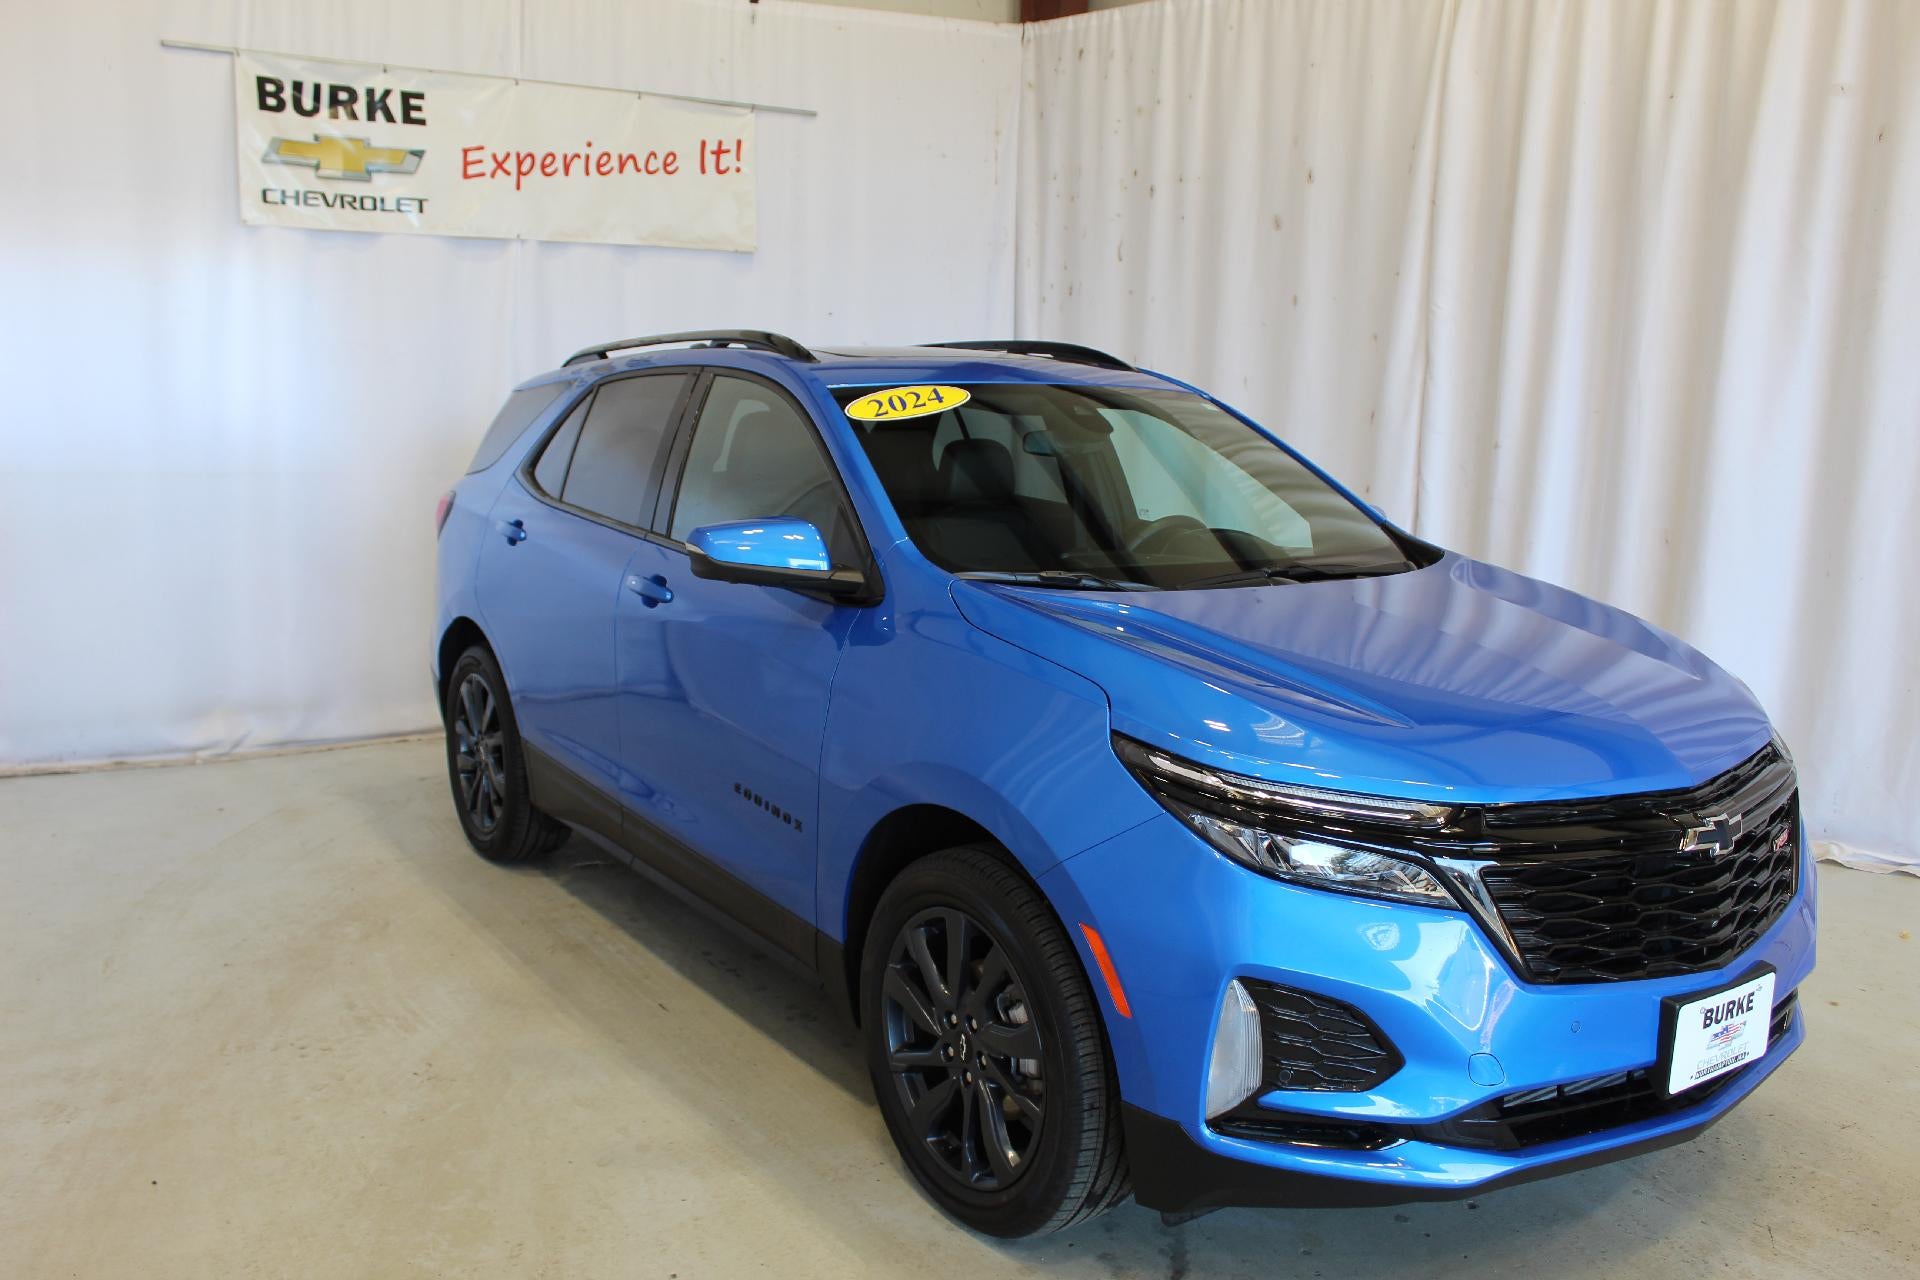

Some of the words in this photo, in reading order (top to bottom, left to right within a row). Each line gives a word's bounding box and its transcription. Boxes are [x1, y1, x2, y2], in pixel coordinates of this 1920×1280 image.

[256, 75, 427, 126] BURKE
[461, 141, 680, 191] Experience
[699, 138, 743, 175] It!
[261, 188, 430, 214] CHEVROLET
[866, 387, 945, 418] 2024
[1702, 991, 1755, 1030] BURKE
[1696, 1041, 1748, 1070] CHEVROLET
